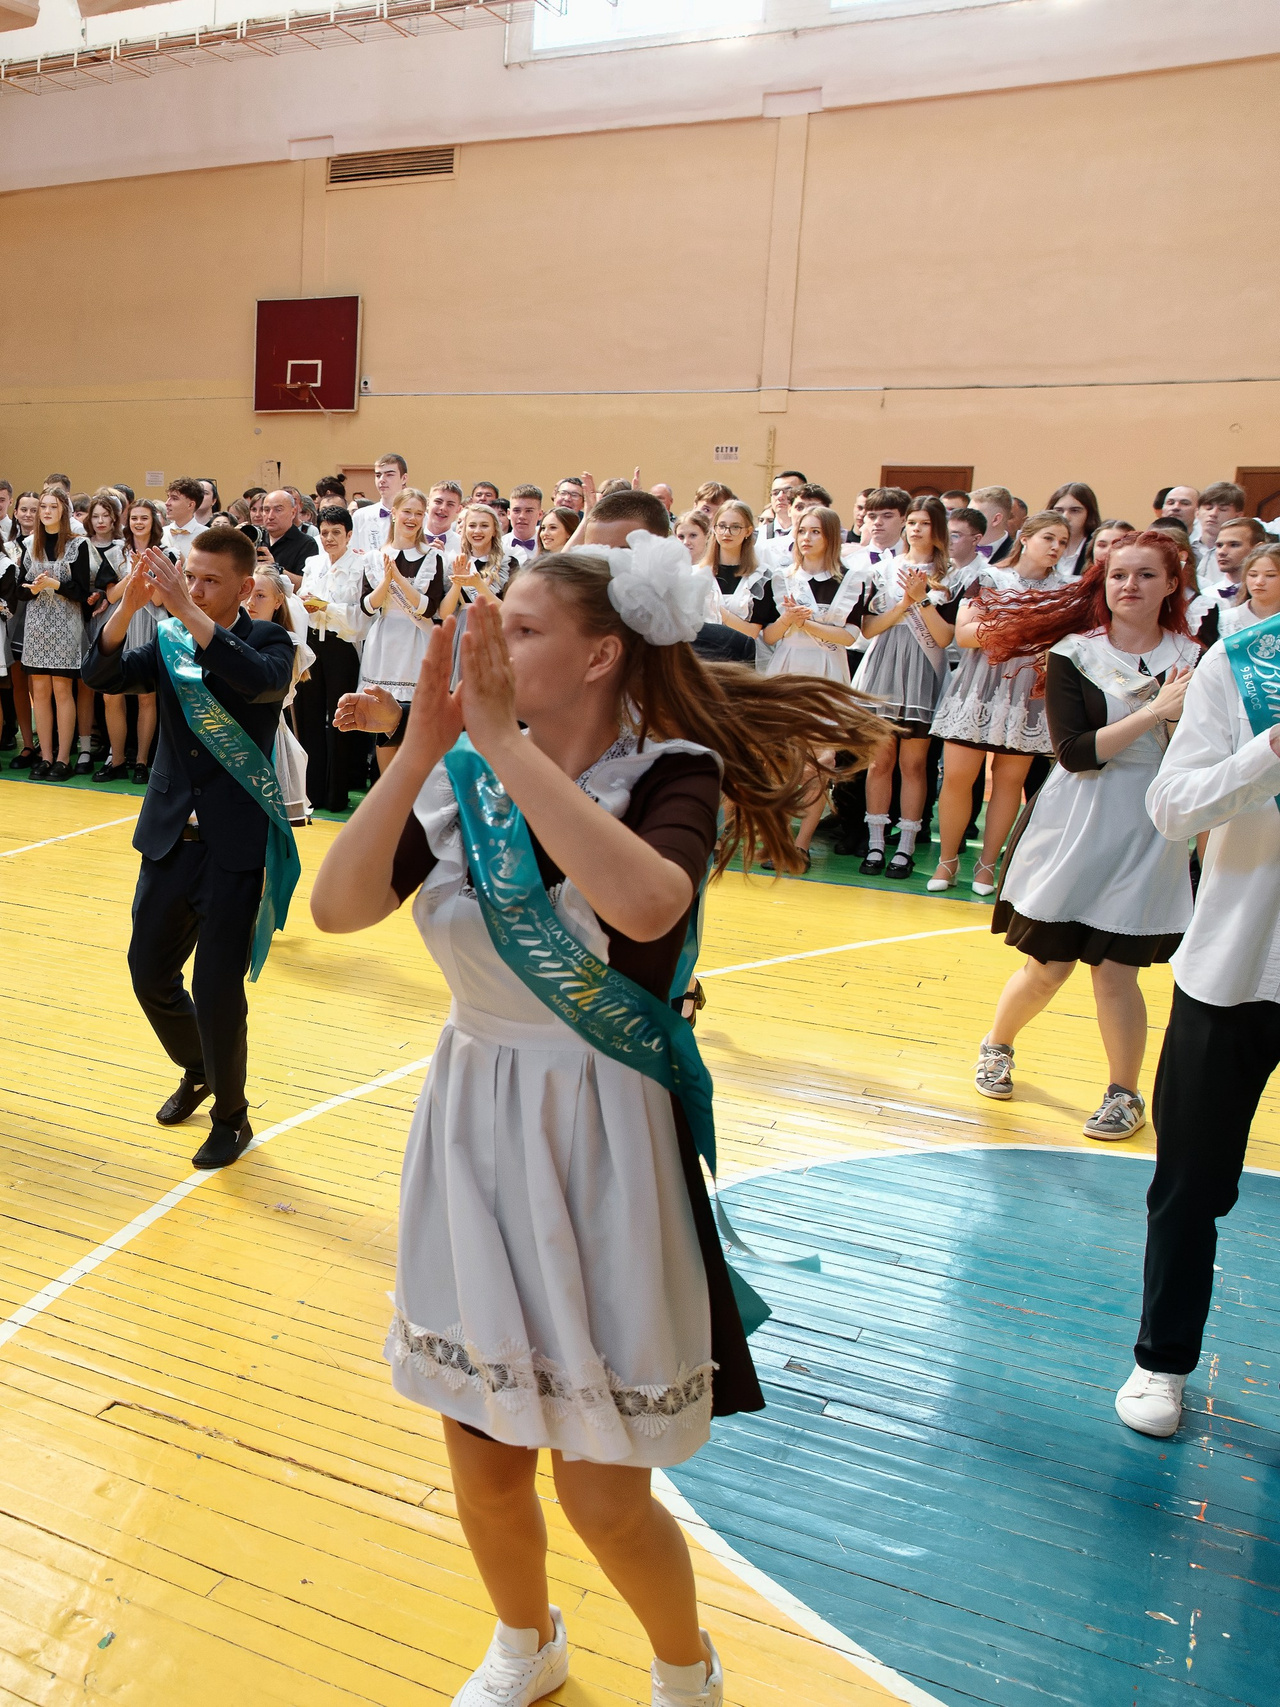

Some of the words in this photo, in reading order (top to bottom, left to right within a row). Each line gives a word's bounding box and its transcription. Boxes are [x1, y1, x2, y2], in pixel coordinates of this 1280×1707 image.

[1240, 665, 1250, 673] 9
[1244, 681, 1262, 711] КЛАСС
[247, 767, 289, 821] 202
[544, 916, 610, 980] ШАТУНОВА
